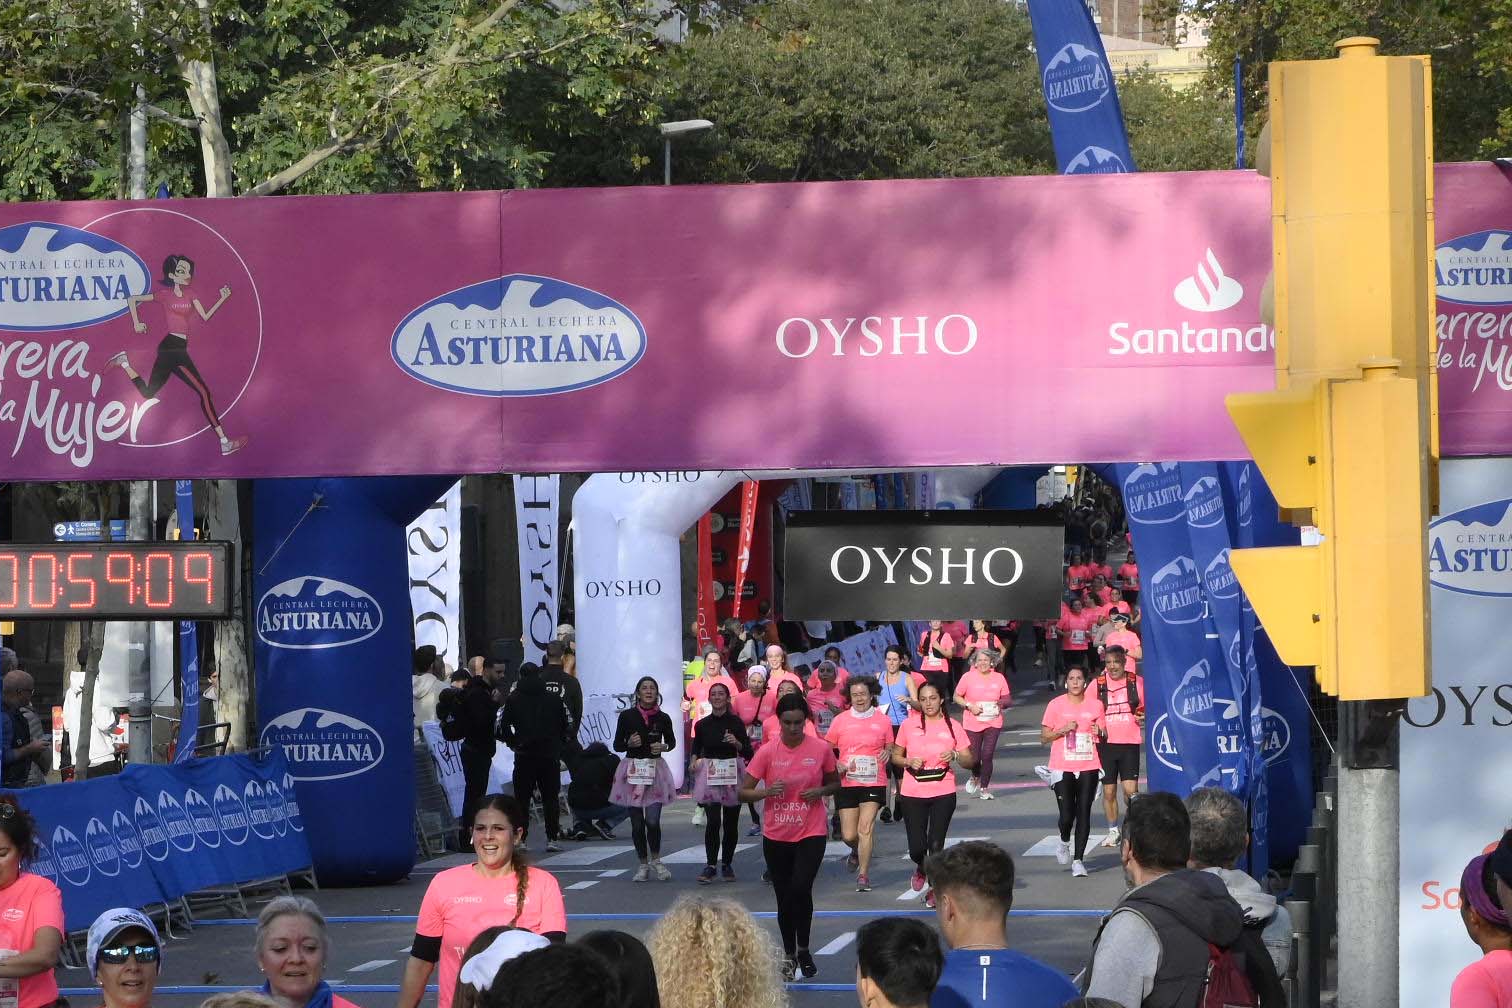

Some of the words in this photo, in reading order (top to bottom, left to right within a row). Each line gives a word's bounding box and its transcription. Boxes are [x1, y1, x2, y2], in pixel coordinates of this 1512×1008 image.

[54, 258, 126, 270] LECHERA
[450, 317, 530, 330] CENTRAL
[536, 314, 618, 328] LECHERA
[411, 321, 626, 367] ASTURIANA
[775, 313, 978, 359] OYSHO
[1109, 322, 1275, 355] Santand
[12, 374, 160, 468] Mujer
[830, 545, 1024, 587] OYSHO
[585, 579, 661, 598] OYSHO
[274, 600, 315, 609] CENTRAL
[319, 600, 369, 609] LECHERA
[261, 605, 373, 632] ASTURIANA
[275, 732, 316, 742] CENTRAL
[320, 732, 370, 741] LECHERA
[774, 802, 808, 811] DORSA
